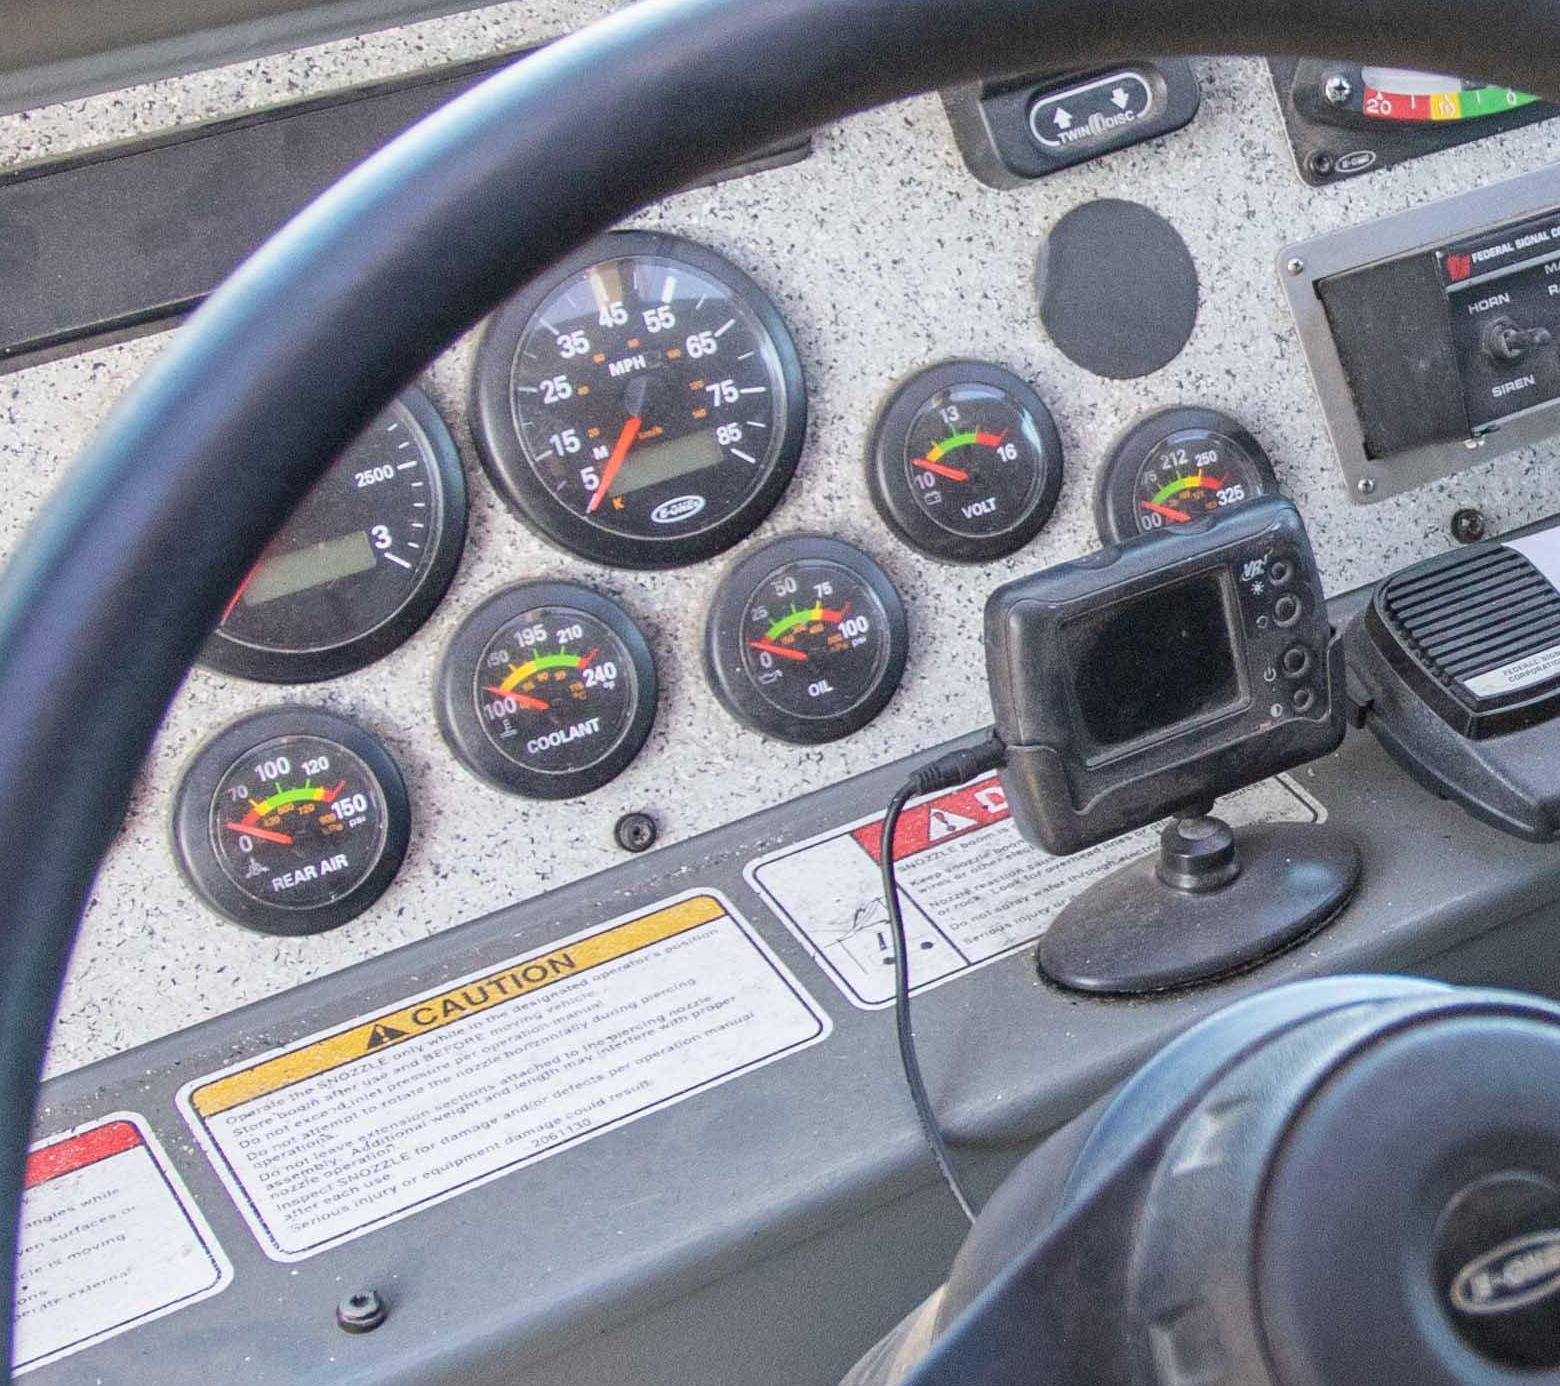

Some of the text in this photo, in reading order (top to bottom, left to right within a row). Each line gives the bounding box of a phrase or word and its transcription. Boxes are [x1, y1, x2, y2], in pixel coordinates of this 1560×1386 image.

[1366, 99, 1392, 115] 20
[1472, 242, 1514, 263] FEDERAL
[1516, 229, 1549, 249] SIGNAL
[598, 302, 628, 328] 45
[1468, 292, 1509, 315] HORN
[642, 306, 676, 333] 55
[557, 330, 589, 359] 35
[686, 331, 717, 359] 65
[608, 355, 646, 377] MPH
[540, 375, 572, 404] 25
[706, 380, 739, 407] 75
[1491, 374, 1535, 399] SIREN
[941, 406, 959, 423] 13
[550, 429, 580, 457] 15
[716, 423, 742, 446] 85
[997, 444, 1018, 462] 16
[1160, 449, 1187, 470] 212
[1194, 450, 1218, 467] 250
[355, 464, 394, 487] 2500
[580, 467, 600, 490] 5
[914, 472, 935, 490] 10
[1216, 485, 1245, 505] 325
[961, 497, 997, 519] VOLT
[372, 525, 392, 549] 3
[771, 577, 797, 597] 50
[813, 581, 833, 598] 75
[514, 624, 547, 647] 195
[556, 624, 583, 644] 210
[838, 615, 869, 639] 100
[583, 662, 617, 688] 240
[808, 680, 834, 697] OIL
[484, 696, 517, 721] 100
[527, 718, 601, 754] COOLANT
[254, 756, 290, 782] 100
[301, 756, 330, 776] 120
[331, 793, 367, 820] 150
[271, 853, 349, 892] REAR AIR
[410, 952, 577, 1026] CAUTION
[512, 979, 588, 1013] designated
[504, 1000, 638, 1059] horizontally during
[317, 1057, 387, 1091] SNOZZLE
[500, 1057, 562, 1086] attached
[530, 1118, 592, 1149] 2061130
